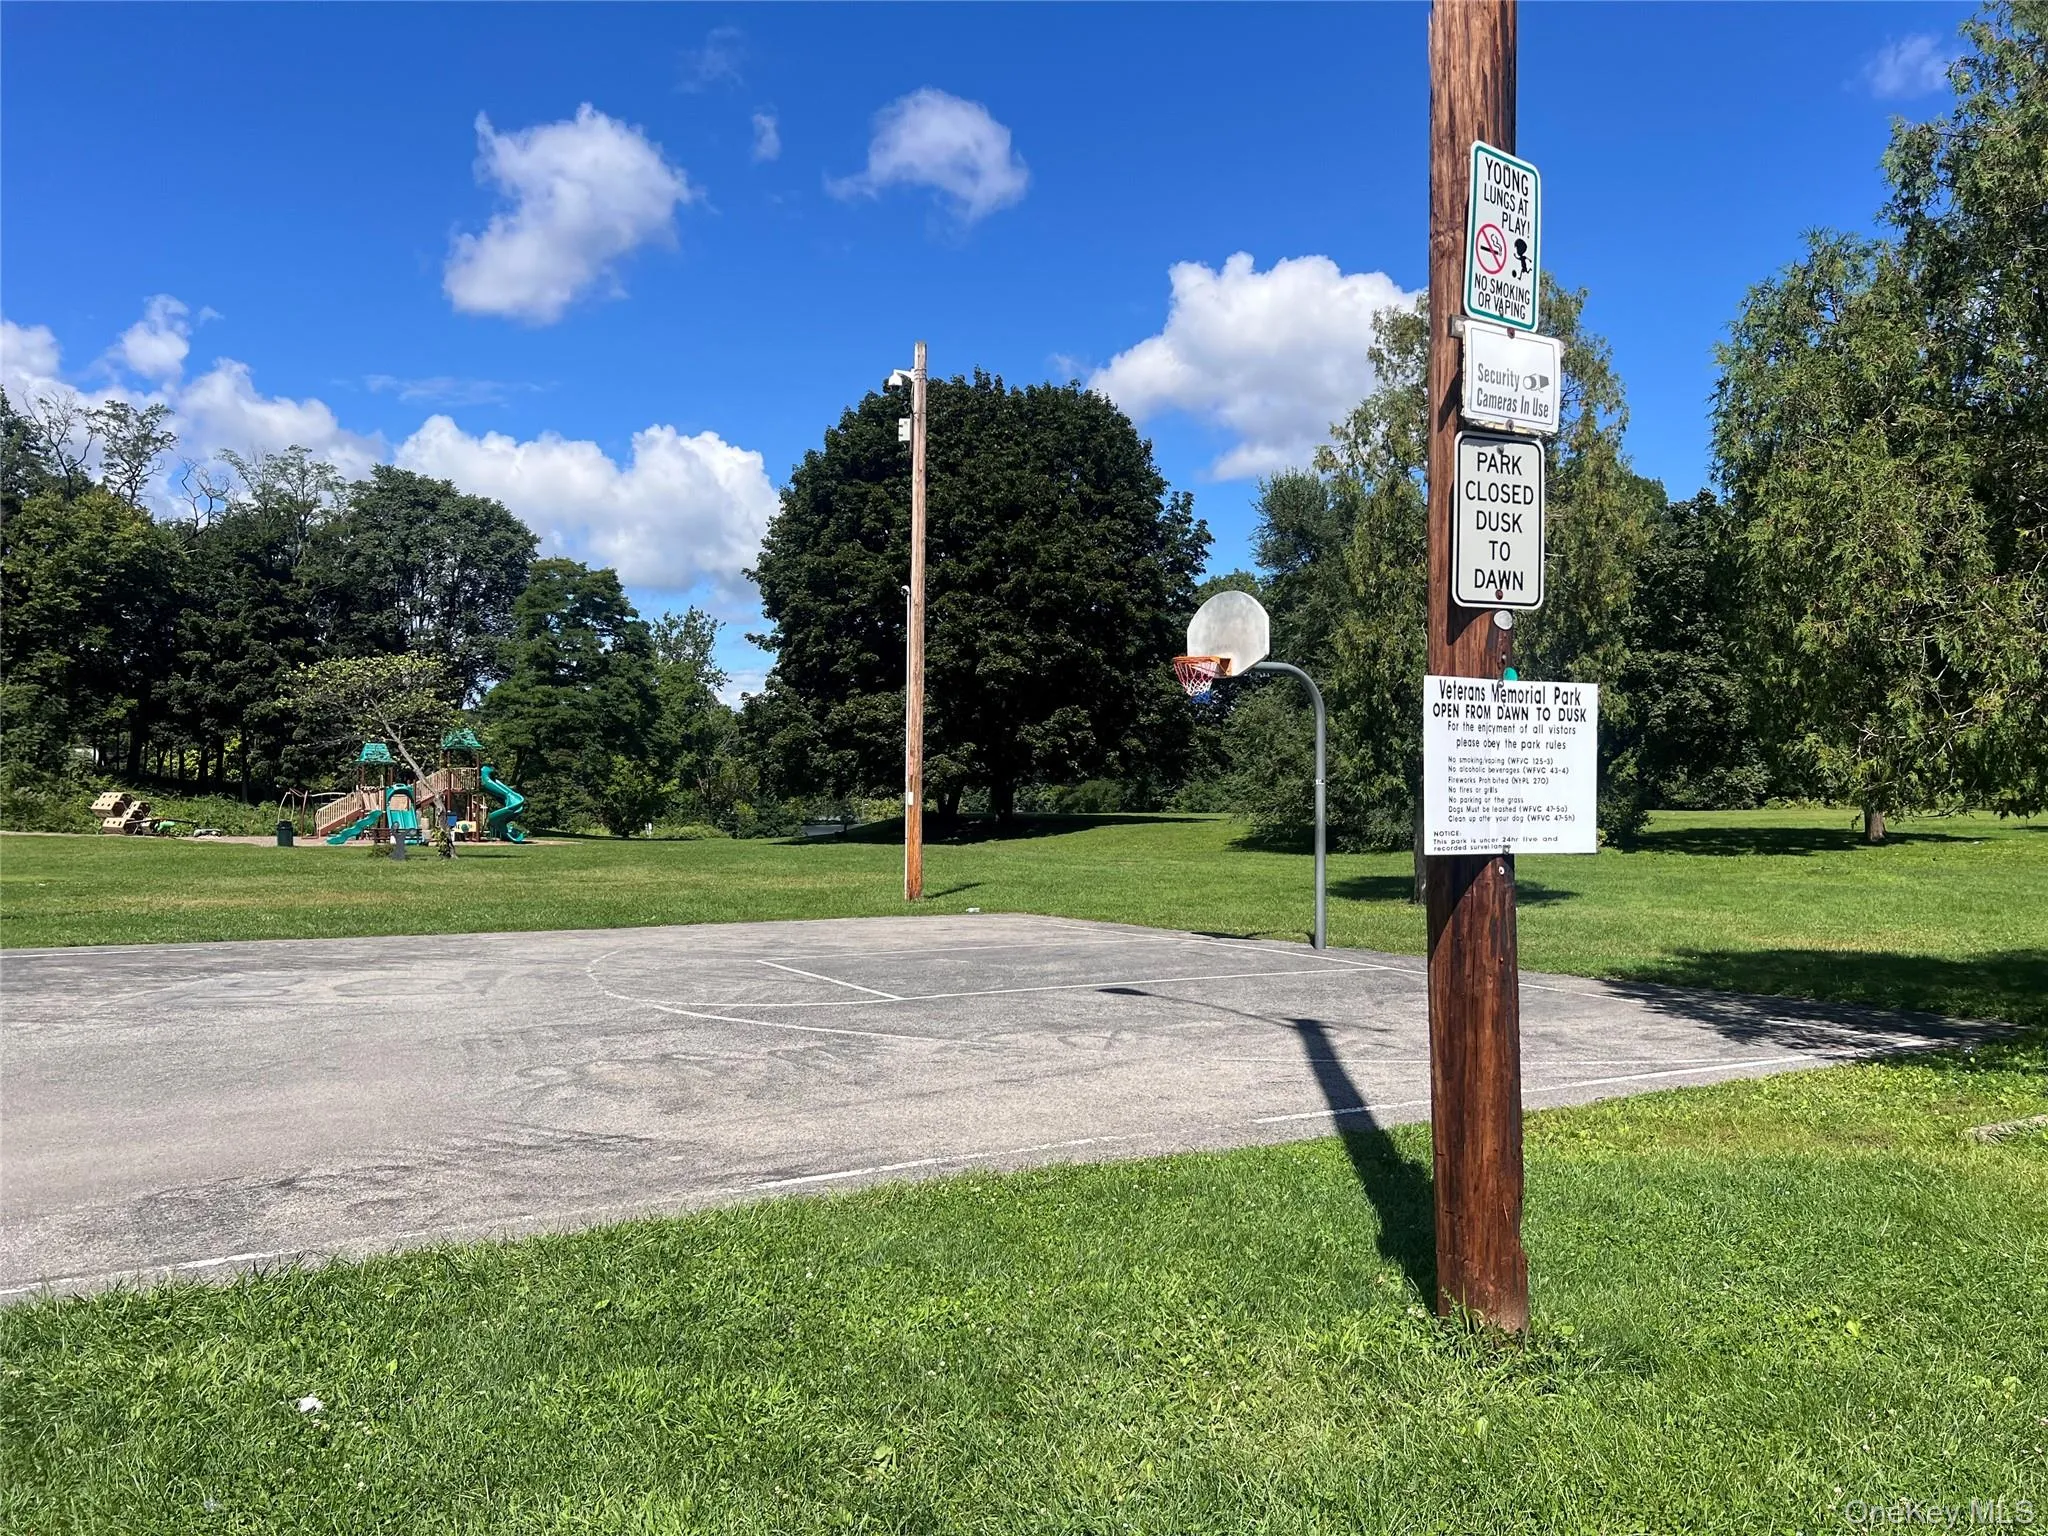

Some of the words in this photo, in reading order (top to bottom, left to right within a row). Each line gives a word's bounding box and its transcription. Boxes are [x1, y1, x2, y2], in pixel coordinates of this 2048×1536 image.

[1485, 157, 1529, 197] YOUNG
[1484, 182, 1515, 212] LUNGS
[1518, 198, 1529, 217] AT
[1502, 211, 1530, 239] PLAY!
[1474, 273, 1488, 291] NO
[1490, 278, 1530, 305] SMOKING
[1478, 291, 1491, 310] OR
[1494, 296, 1526, 320] VAPING
[1478, 363, 1520, 392] Security
[1477, 388, 1518, 413] Cameras
[1520, 395, 1530, 415] In
[1532, 398, 1549, 418] Use
[1477, 452, 1522, 476] PARK
[1465, 480, 1534, 505] CLOSED
[1476, 510, 1522, 533] DUSK
[1488, 540, 1511, 561] TO
[1474, 568, 1524, 591] DAWN
[1439, 679, 1486, 702] Veterans
[1491, 683, 1546, 705] Memorial
[1553, 686, 1581, 706] Park
[1432, 702, 1460, 718] OPEN
[1465, 704, 1491, 720] FROM
[1497, 705, 1529, 721] DAWN
[1536, 707, 1551, 722] TO
[1558, 708, 1587, 723] DUSK
[1447, 720, 1459, 732] For
[1462, 721, 1475, 733] the
[1519, 724, 1528, 735] of
[1532, 724, 1544, 735] all
[1456, 737, 1480, 748] please
[1483, 739, 1500, 750] obey
[1505, 739, 1518, 749] the
[1521, 739, 1541, 751] park
[1545, 740, 1567, 751] rules
[1448, 756, 1457, 764] No
[1448, 765, 1457, 773] No
[1448, 786, 1457, 794] No
[1459, 786, 1473, 794] fires
[1448, 796, 1457, 804] No
[1459, 797, 1482, 805] parking
[1494, 796, 1505, 804] the
[1508, 797, 1524, 805] grass
[1448, 805, 1464, 814] Dogs
[1448, 815, 1466, 823] Clean
[1469, 816, 1477, 824] up
[1495, 816, 1509, 824] your
[1512, 815, 1524, 824] dog
[1433, 838, 1448, 846] This
